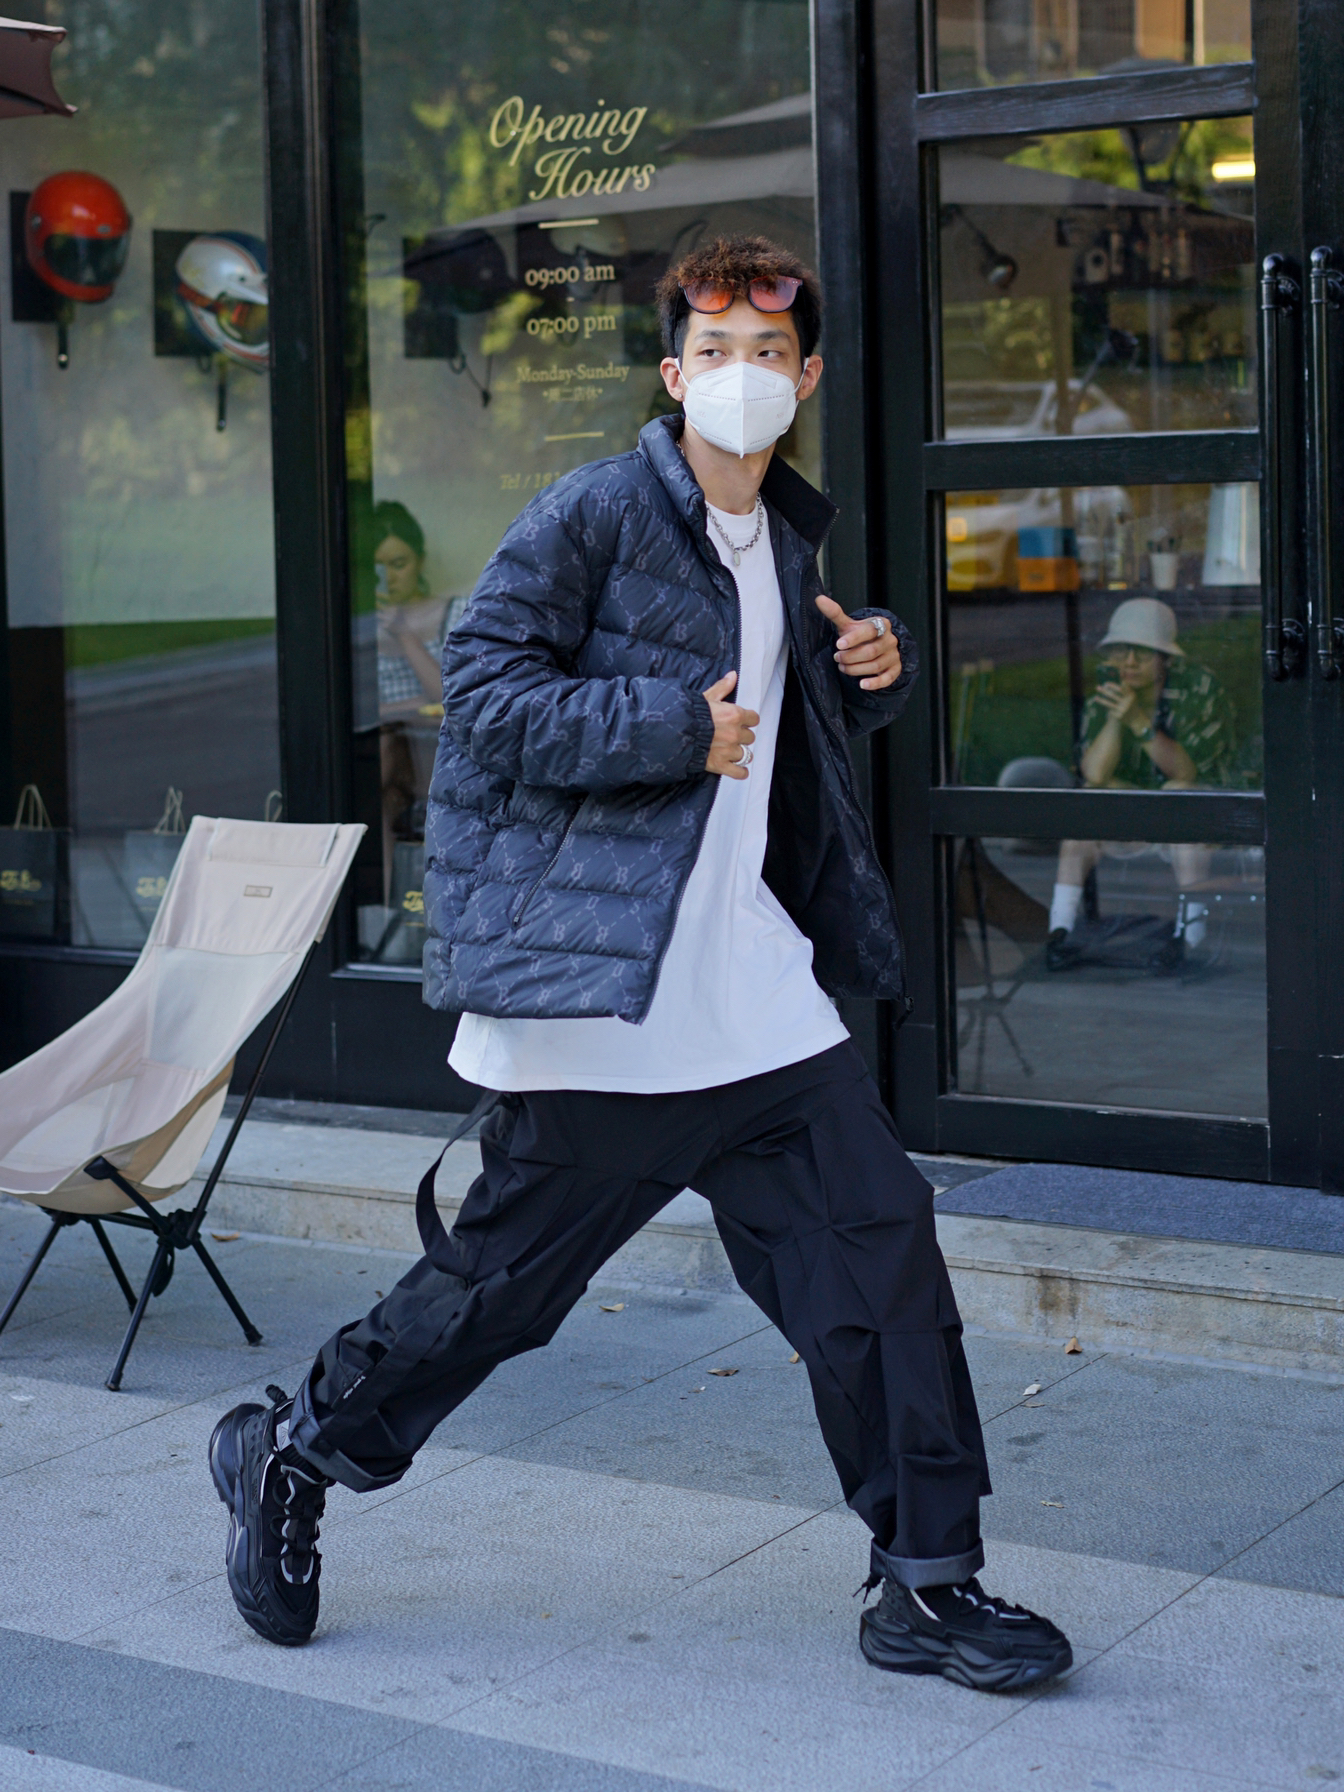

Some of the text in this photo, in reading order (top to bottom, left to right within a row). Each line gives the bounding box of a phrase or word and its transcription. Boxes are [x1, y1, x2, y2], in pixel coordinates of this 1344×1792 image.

[490, 95, 648, 167] Opening
[528, 146, 656, 200] Hours
[525, 264, 616, 289] 09:00 am
[526, 315, 617, 338] 07:00 pm
[501, 473, 521, 490] Tel
